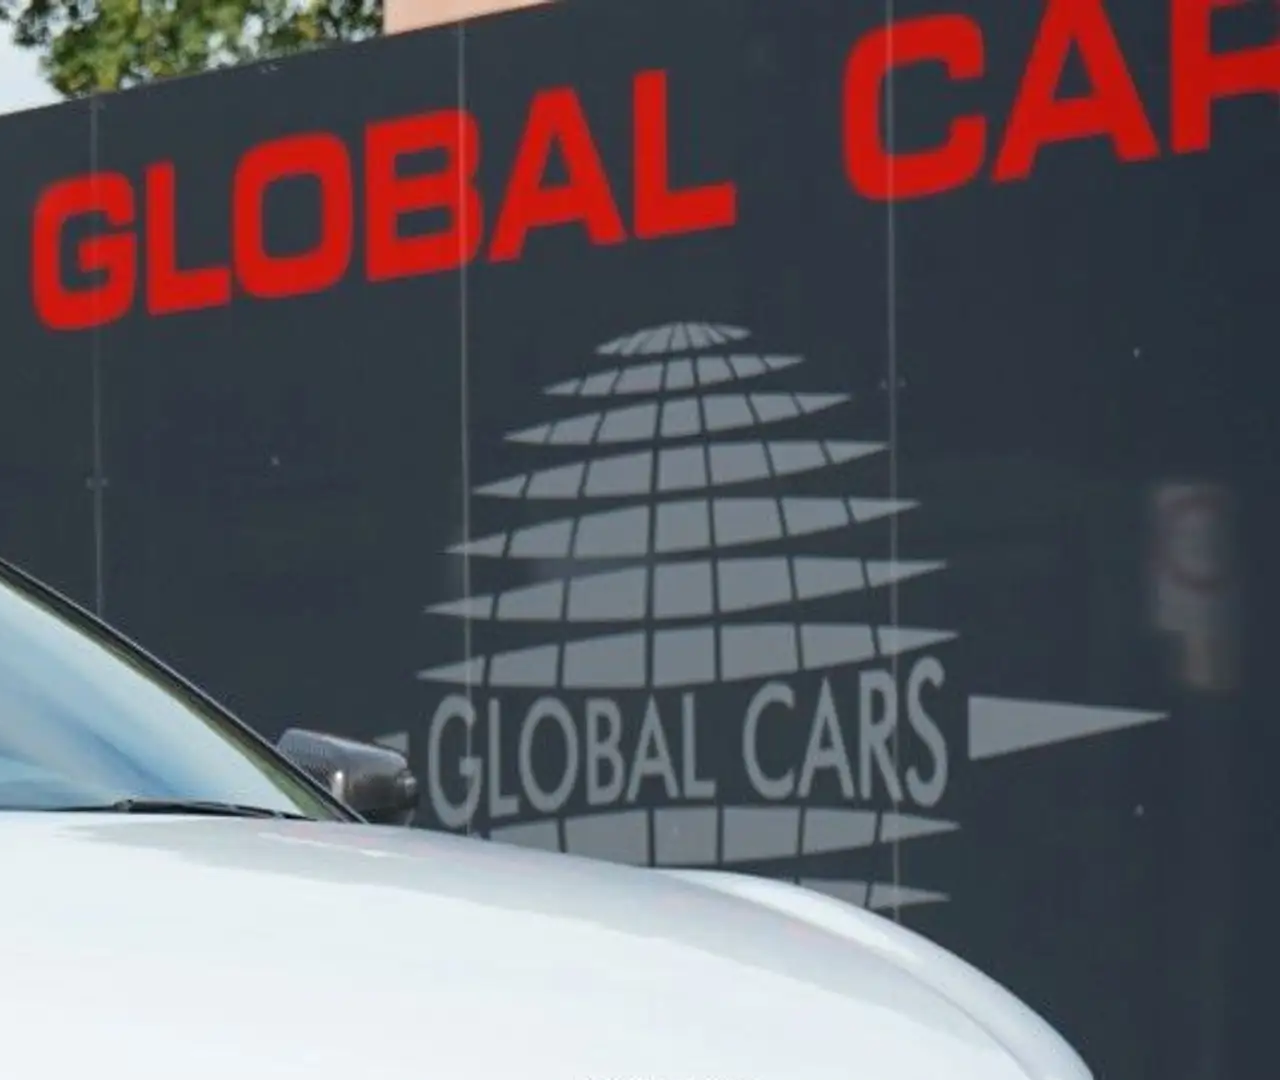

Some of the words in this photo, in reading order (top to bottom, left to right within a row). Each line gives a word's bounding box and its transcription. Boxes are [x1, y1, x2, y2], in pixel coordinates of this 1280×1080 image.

[33, 70, 737, 330] GLOBAL
[428, 692, 716, 827] GLOBAL
[742, 656, 948, 808] CARS
